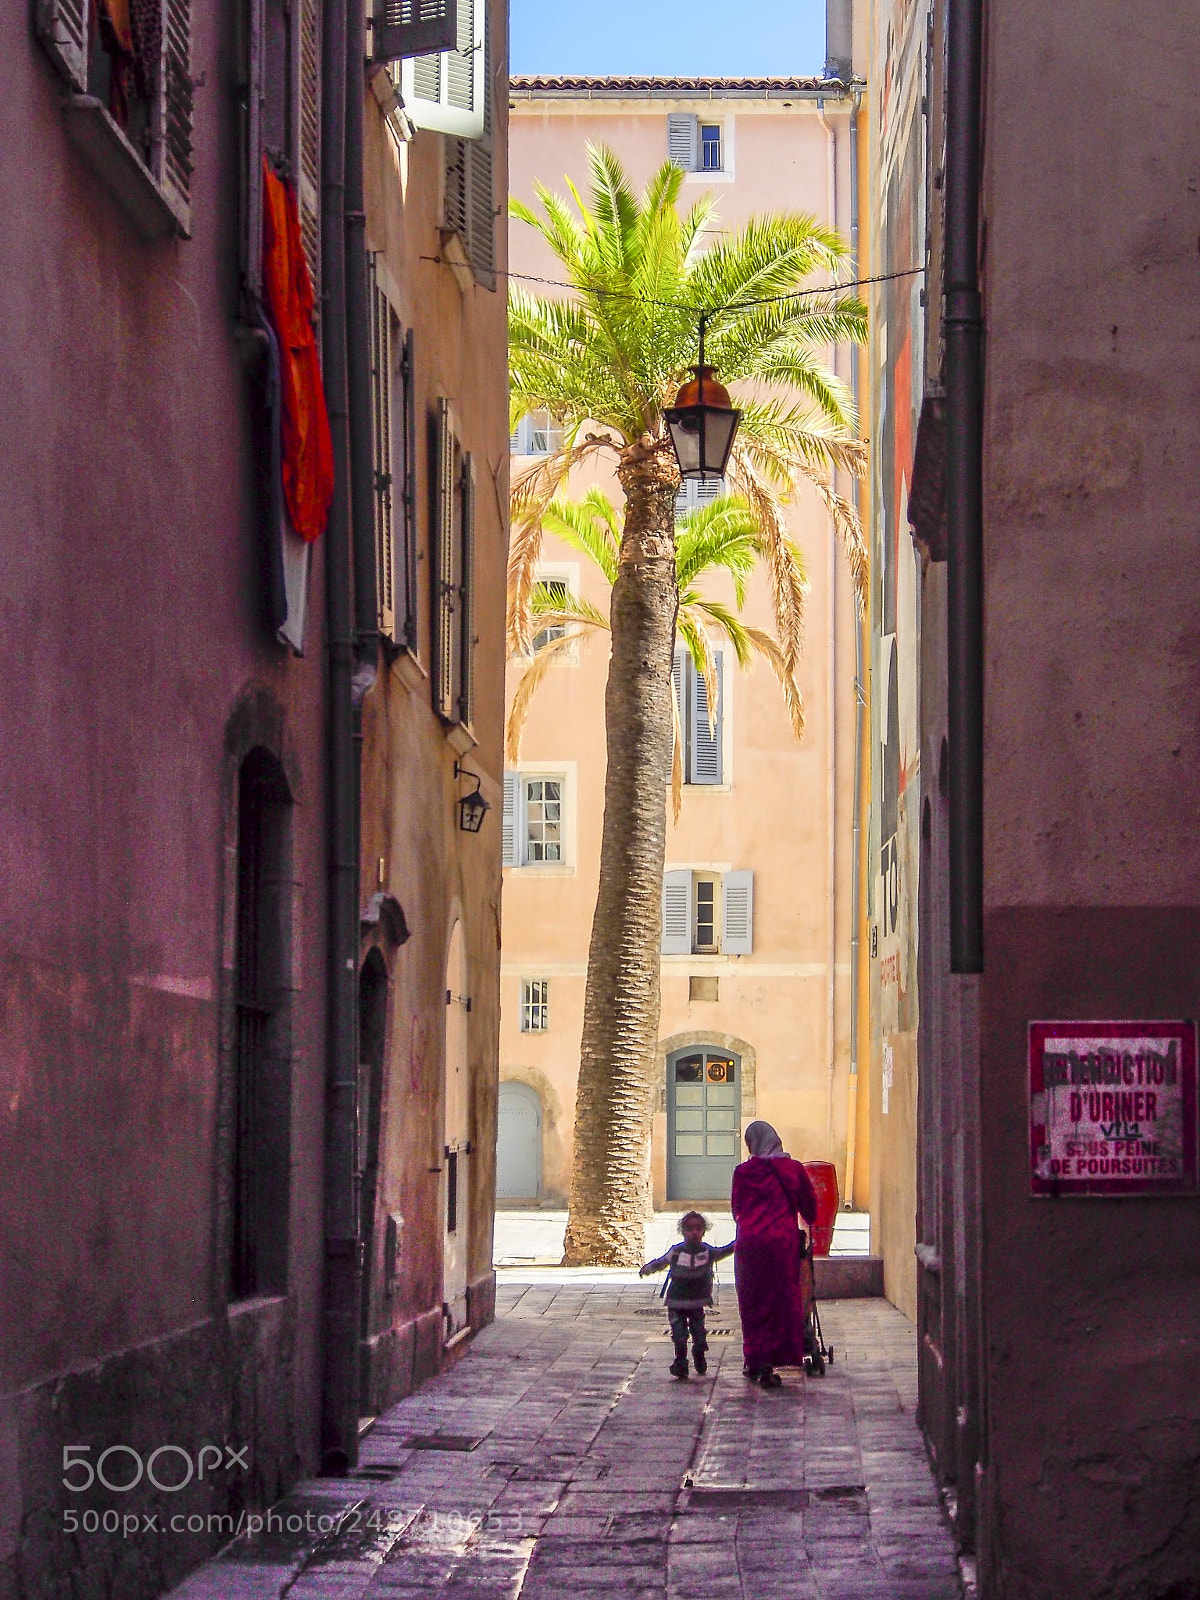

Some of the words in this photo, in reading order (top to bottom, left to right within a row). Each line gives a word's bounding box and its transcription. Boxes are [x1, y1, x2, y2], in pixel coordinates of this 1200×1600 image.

[1044, 1053, 1176, 1085] ERDICTIO
[1070, 1092, 1157, 1121] D'URINER
[1067, 1141, 1108, 1156] SOUS
[1115, 1141, 1161, 1156] PEINE
[1051, 1159, 1070, 1174] DE
[1078, 1159, 1178, 1174] POURSUITES
